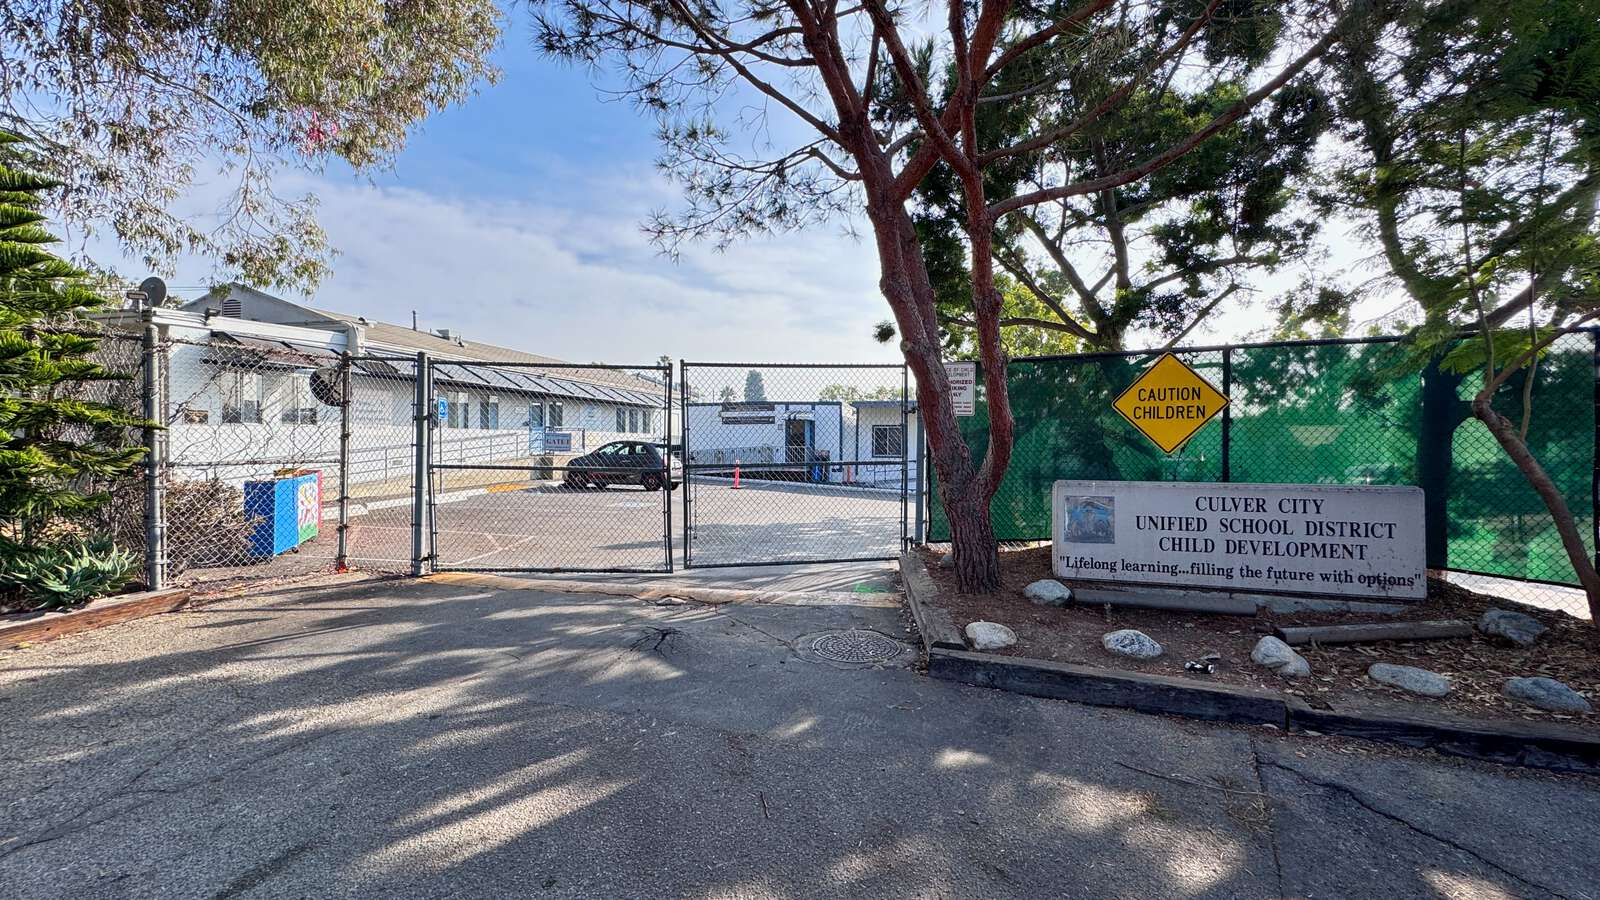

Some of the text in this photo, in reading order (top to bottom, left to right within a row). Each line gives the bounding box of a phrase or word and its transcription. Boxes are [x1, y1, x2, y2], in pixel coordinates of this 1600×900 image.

[1137, 387, 1201, 402] CAUTION
[1133, 405, 1206, 420] CHILDREN
[1195, 496, 1325, 515] CULVER CITY
[1136, 515, 1397, 539] UNIFIED SCHOOL DISTRICT
[1159, 536, 1368, 560] CHILD DEVELOPMENT
[1059, 555, 1118, 573] "Lifelong
[1239, 565, 1263, 579] the
[1266, 566, 1314, 582] future
[1319, 569, 1353, 584] with
[1357, 572, 1421, 588] options"
